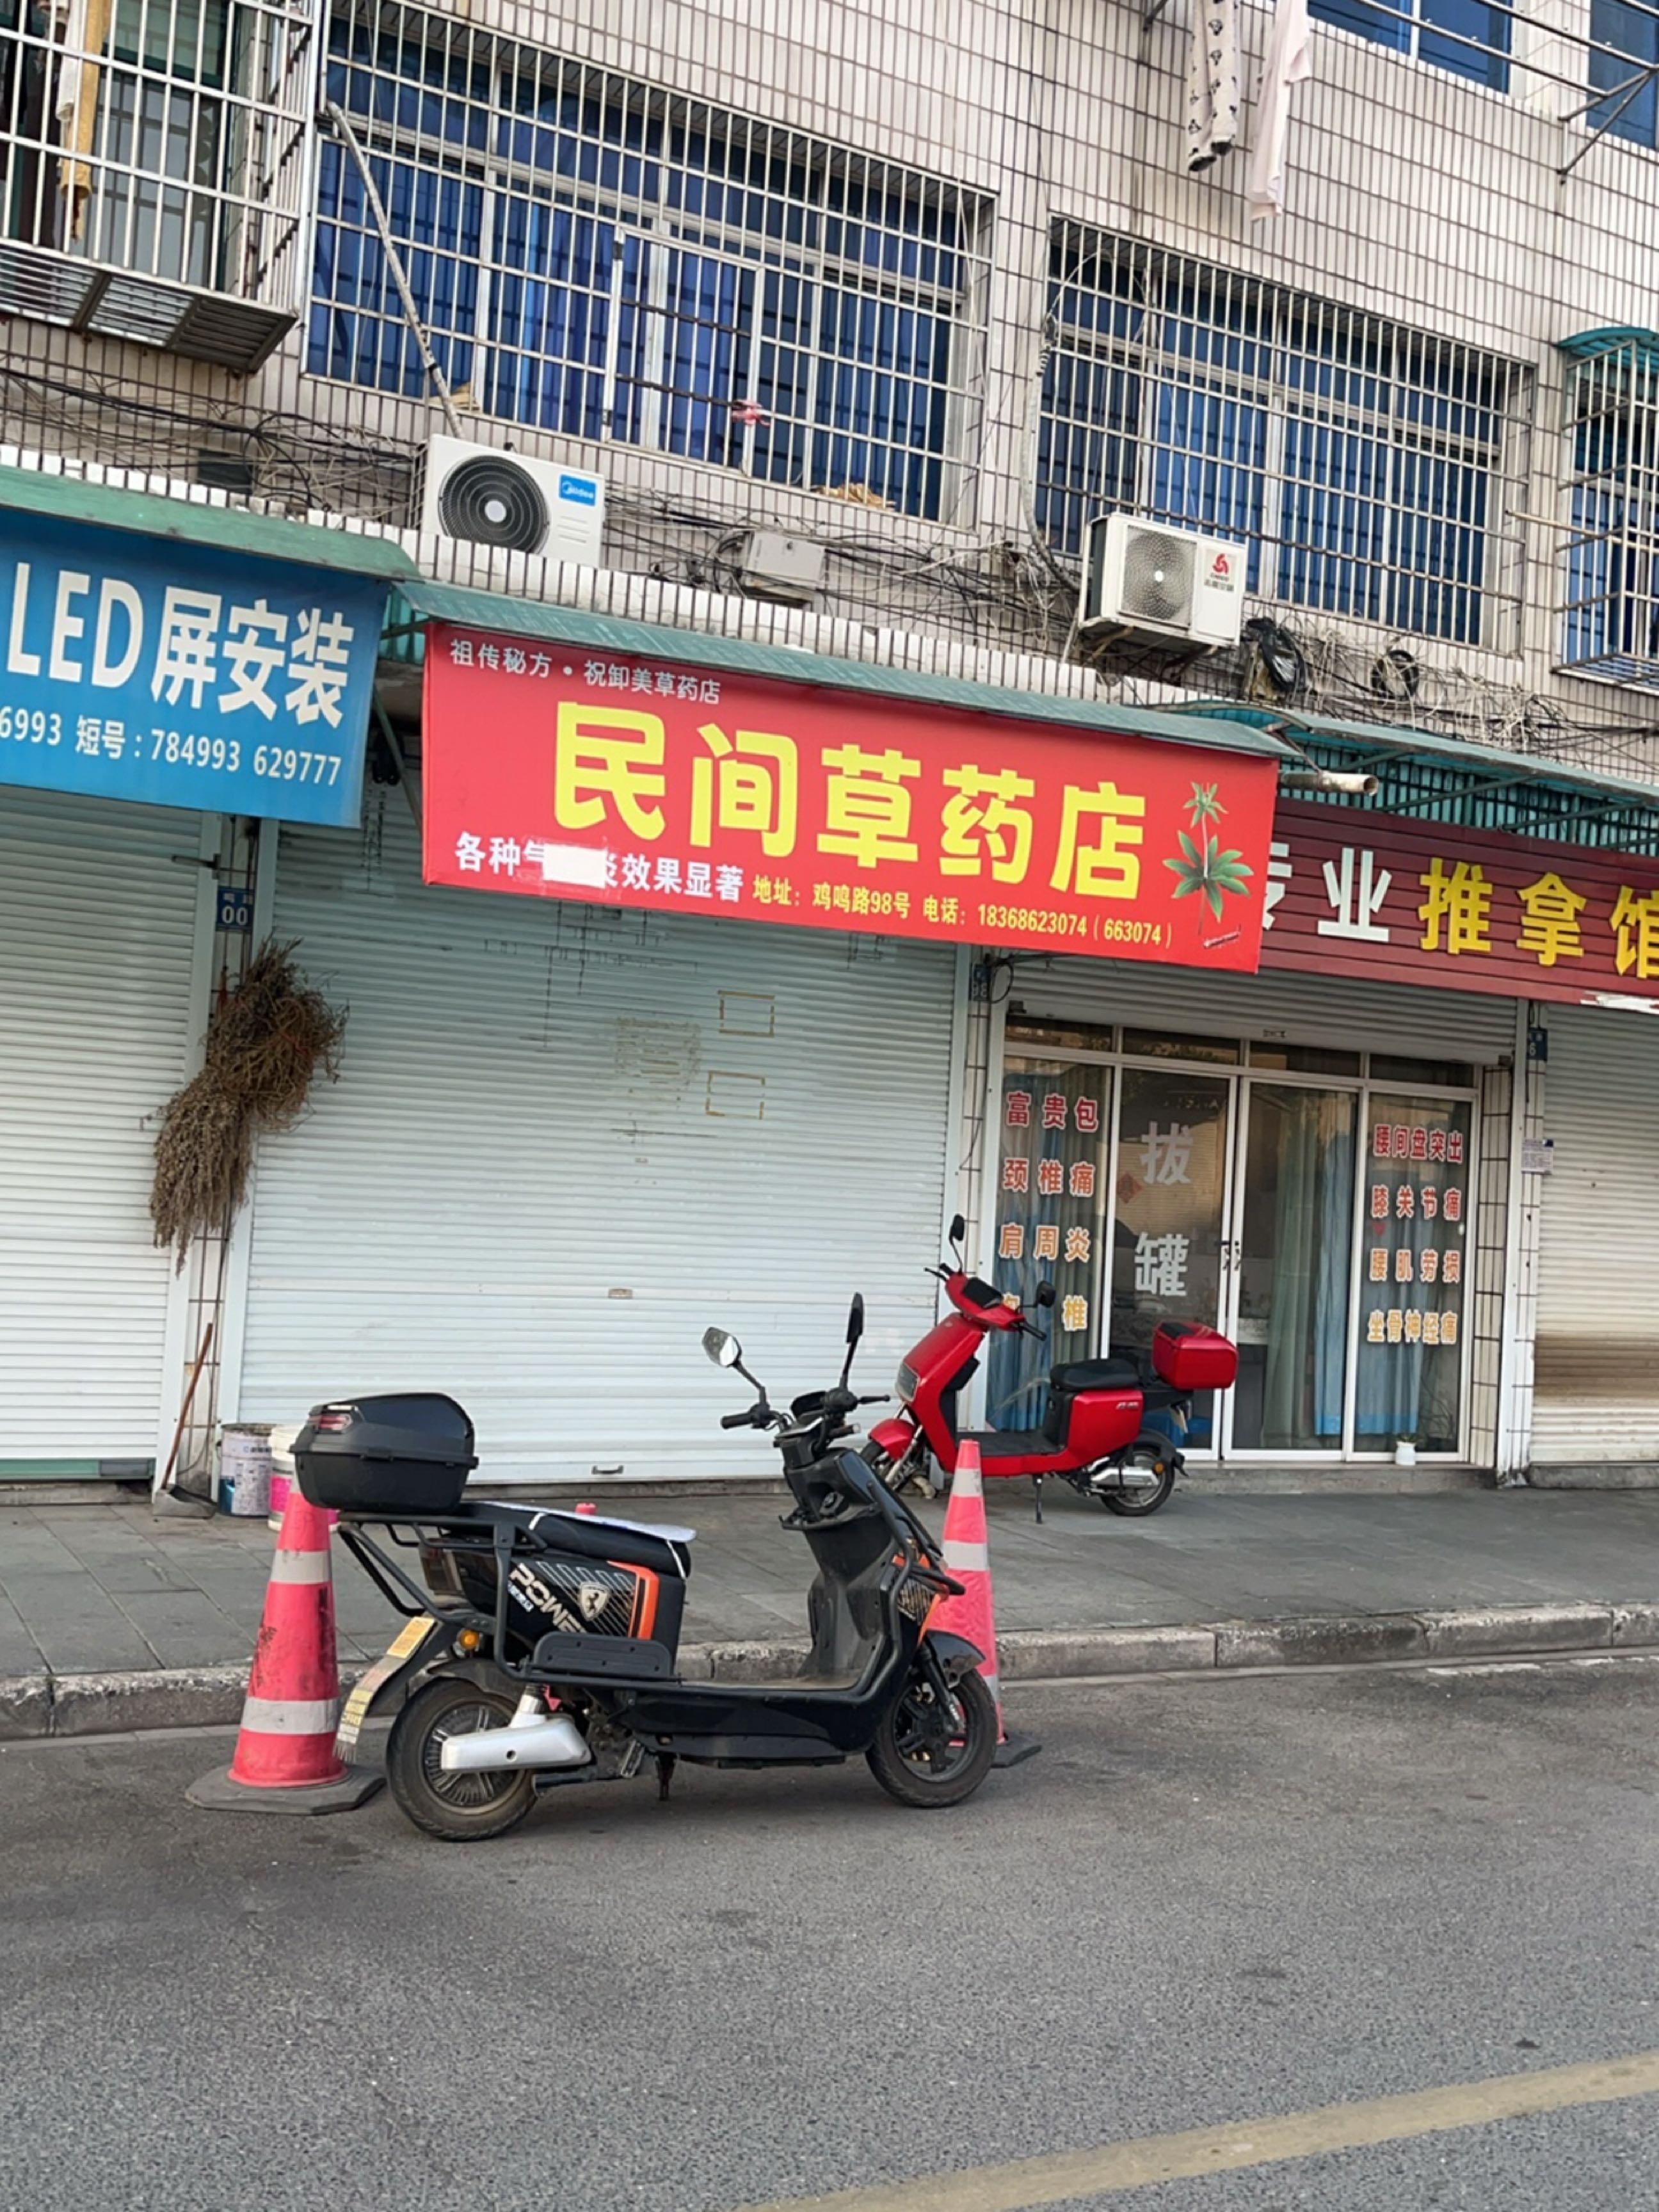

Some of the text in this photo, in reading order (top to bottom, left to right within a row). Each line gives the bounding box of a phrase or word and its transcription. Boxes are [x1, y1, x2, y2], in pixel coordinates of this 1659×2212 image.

[7, 563, 355, 728] LED屏安装
[253, 746, 342, 786] 629777
[554, 701, 1146, 899] 民间草药店
[455, 831, 744, 902] 各种气效果显著
[1007, 1091, 1098, 1133] 富贵包
[1374, 1124, 1463, 1165] 腰间盘突出
[1004, 1158, 1095, 1197] 颈椎痛
[1372, 1185, 1461, 1221] 膝关节痛
[998, 1222, 1090, 1263] 肩周炎
[1369, 1248, 1460, 1283] 腰肌劳损
[1367, 1309, 1457, 1345] 坐骨神经痛
[509, 1562, 588, 1633] POWE
